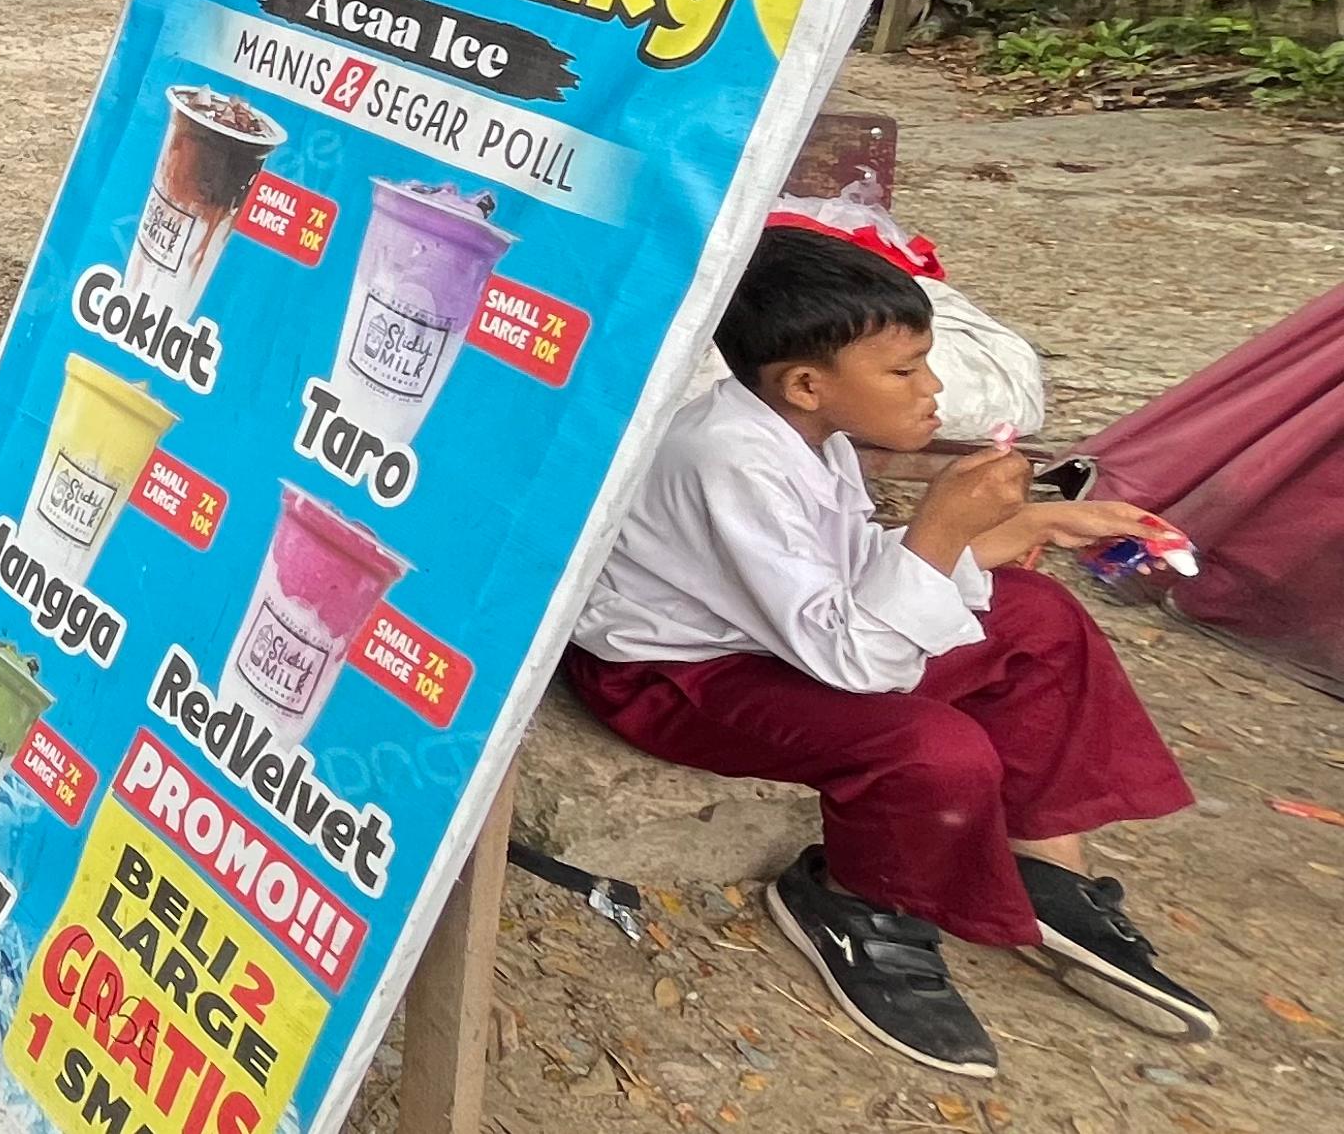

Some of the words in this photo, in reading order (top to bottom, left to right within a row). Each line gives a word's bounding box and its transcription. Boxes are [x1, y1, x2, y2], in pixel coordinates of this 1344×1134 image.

[434, 19, 511, 81] Ice
[234, 29, 333, 96] MANIS
[365, 79, 471, 153] SEGAR
[478, 119, 577, 193] POLLL
[248, 204, 291, 237] LARGE
[299, 227, 324, 252] 10K
[256, 184, 298, 217] SMALL
[306, 206, 329, 230] 7K
[78, 271, 215, 388] Coklat
[478, 311, 531, 351] LARGE
[531, 335, 561, 365] 10K
[485, 287, 543, 329] SMALL
[539, 313, 567, 339] 7K
[301, 384, 412, 500] Taro
[141, 480, 182, 517] LARGE
[190, 509, 214, 538] 10K
[149, 461, 192, 499] SMALL
[198, 491, 220, 517] 7K
[363, 640, 414, 684] LARGE
[414, 671, 446, 705] 10K
[372, 617, 422, 665] SMALL
[424, 650, 451, 679] 7K
[22, 749, 57, 789] LARGE
[54, 778, 77, 808] 10K
[30, 732, 66, 773] SMALL
[65, 762, 83, 788] 7K
[152, 652, 387, 891] RedVelvet
[120, 741, 352, 979] PROMO!!!
[114, 842, 240, 985] BELI
[228, 961, 277, 1027] 2
[95, 882, 280, 1088] LARGE
[26, 1011, 54, 1063] 1
[54, 1047, 156, 1134] SM
